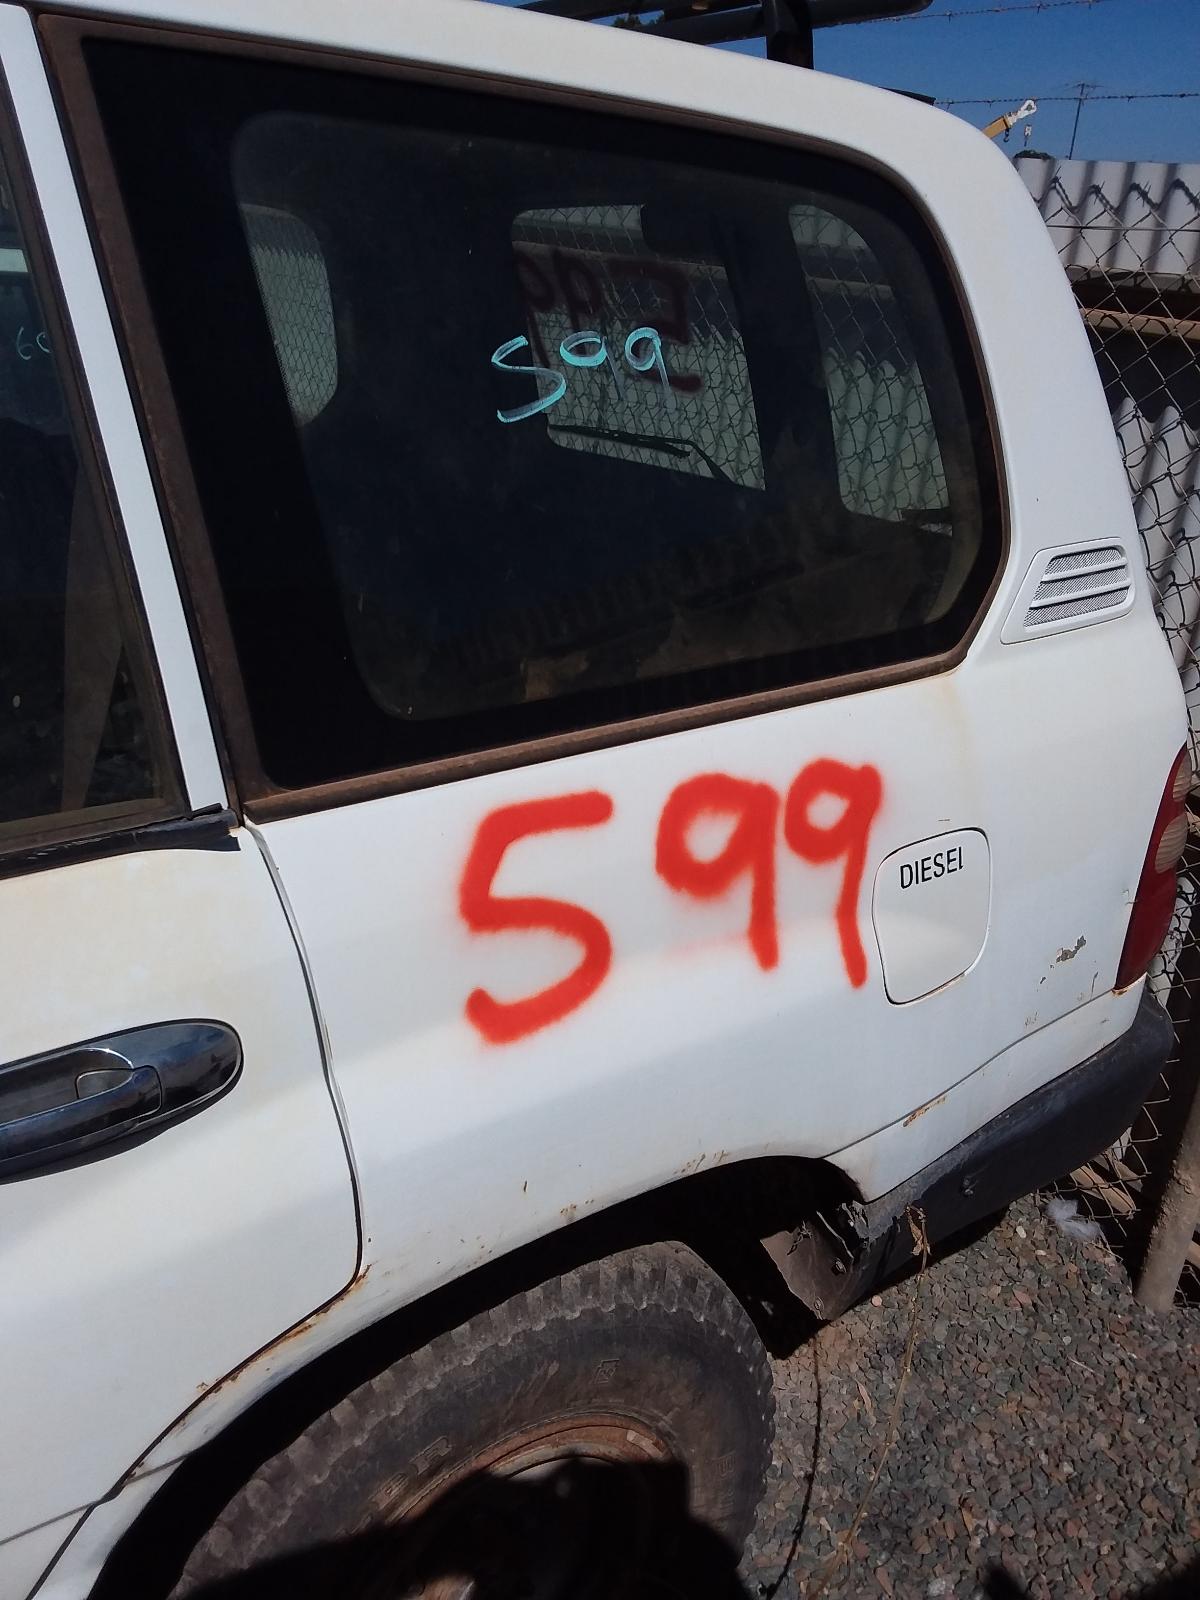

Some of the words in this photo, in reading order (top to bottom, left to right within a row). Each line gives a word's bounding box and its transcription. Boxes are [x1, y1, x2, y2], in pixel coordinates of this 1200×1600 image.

[491, 327, 678, 423] 599
[459, 757, 883, 1045] 599
[899, 846, 963, 890] DIESEL
